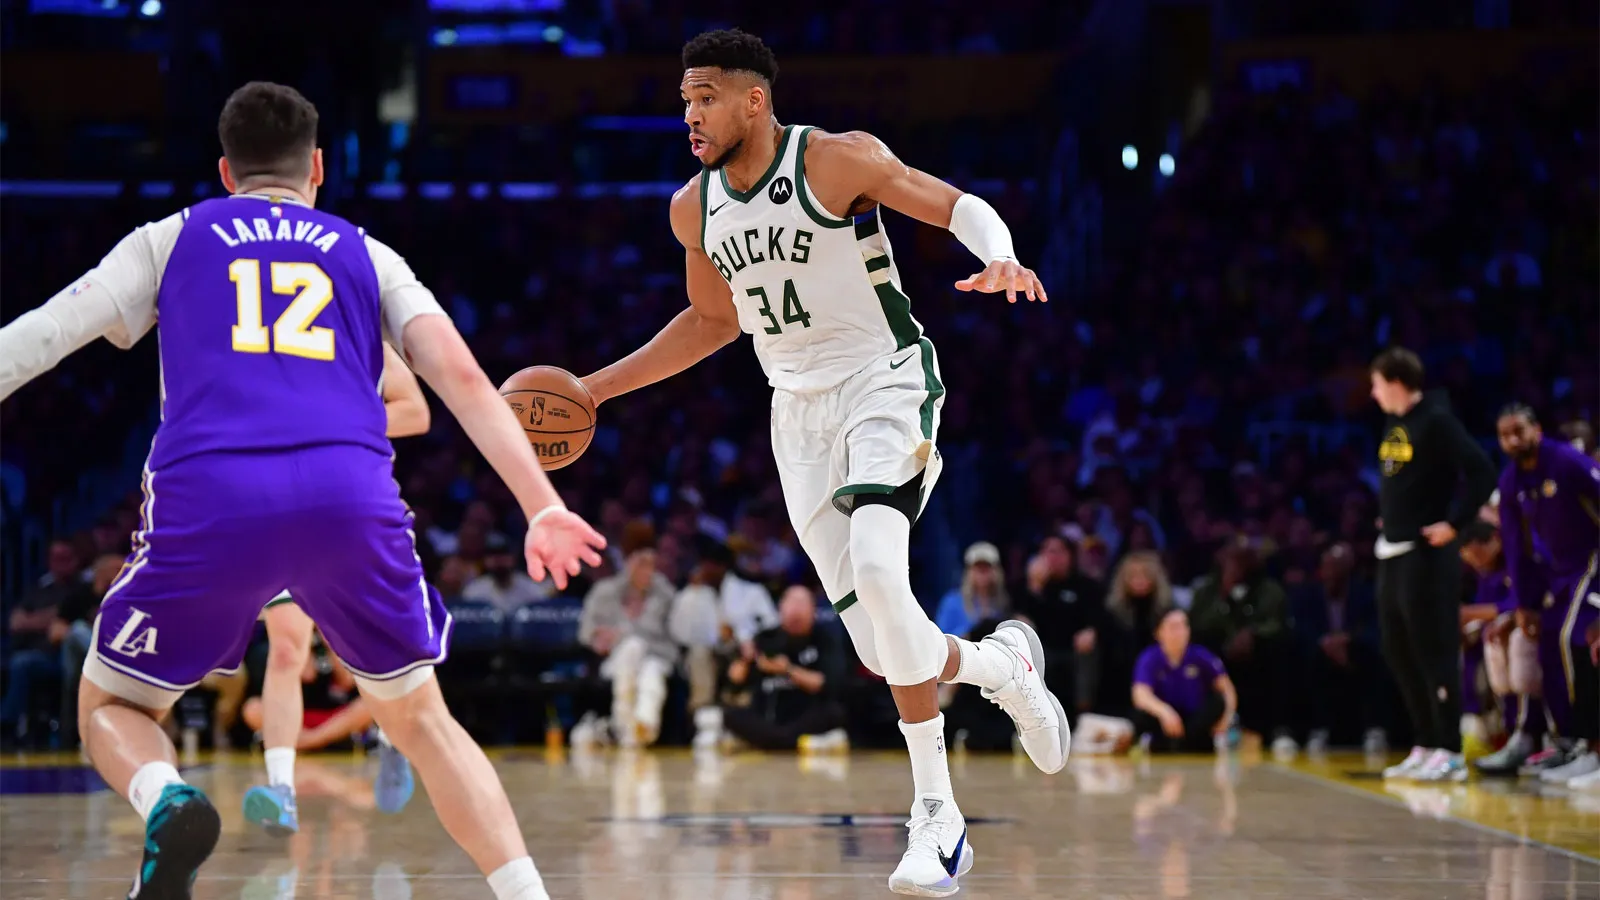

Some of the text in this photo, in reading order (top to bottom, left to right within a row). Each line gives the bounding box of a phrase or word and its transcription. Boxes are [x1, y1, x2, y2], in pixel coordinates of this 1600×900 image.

[211, 217, 341, 254] LARAVIA
[711, 226, 814, 283] BUCKS
[228, 258, 336, 361] 12
[746, 278, 811, 335] 34
[104, 606, 159, 658] LA
